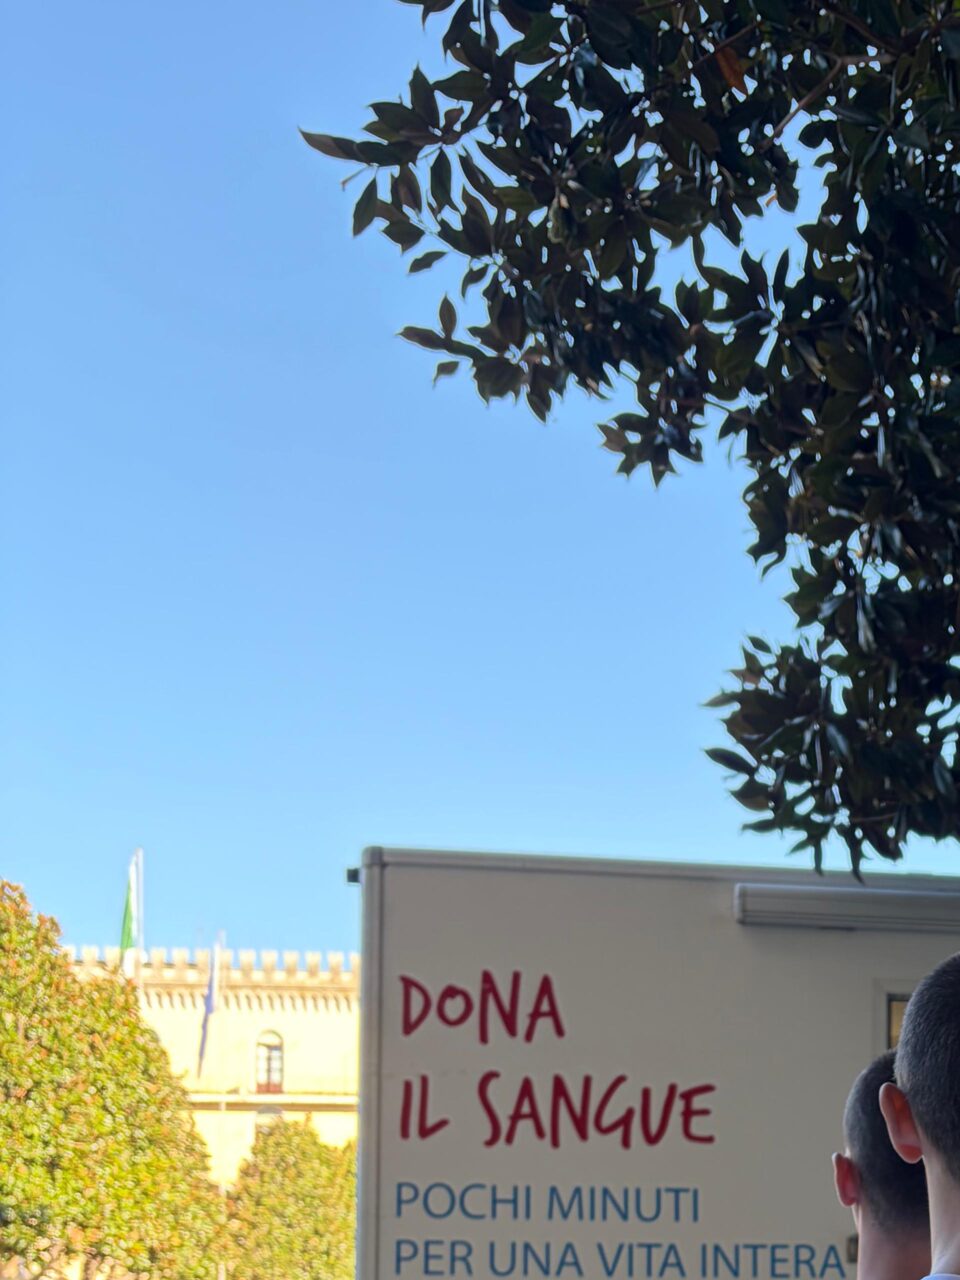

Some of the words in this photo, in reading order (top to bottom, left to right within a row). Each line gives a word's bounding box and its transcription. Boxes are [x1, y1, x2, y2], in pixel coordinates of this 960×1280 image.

[399, 969, 565, 1045] DONA
[399, 1075, 450, 1141] IL
[477, 1070, 717, 1149] SANGUE
[395, 1182, 531, 1222] POCHI
[548, 1186, 699, 1223] MINUTI
[395, 1239, 474, 1277] PER
[489, 1241, 584, 1277] UNA
[597, 1242, 687, 1278] VITA
[701, 1243, 847, 1280] INTERA
